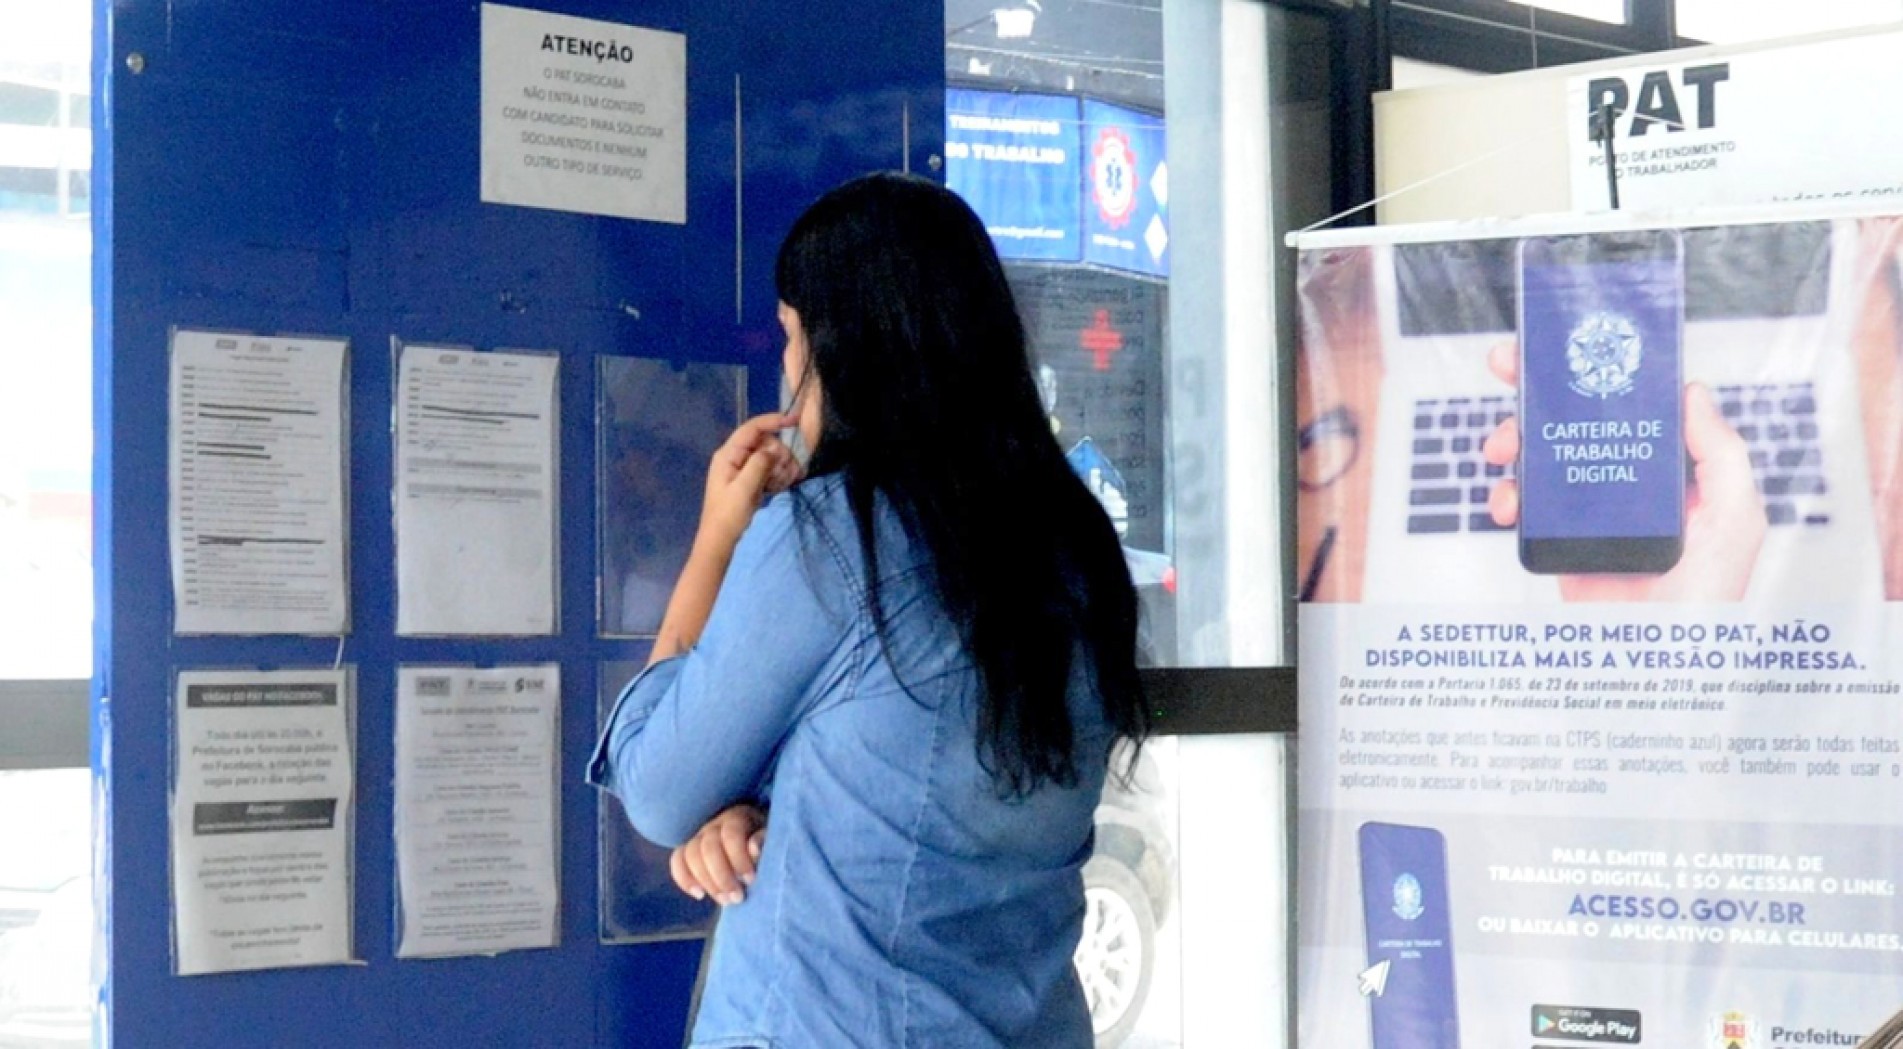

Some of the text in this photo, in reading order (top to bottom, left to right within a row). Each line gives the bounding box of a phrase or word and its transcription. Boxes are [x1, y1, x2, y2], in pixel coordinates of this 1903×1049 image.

[541, 33, 633, 63] ATENÇÃO
[543, 68, 626, 89] O PAT SOROCABA
[523, 85, 646, 115] NÃO ENTRA EM CONTATO
[1588, 62, 1730, 141] PAT
[502, 106, 664, 138] COM CANDIDATO PARA SOLICITAR
[521, 131, 592, 153] DOCUMENTOS
[603, 142, 647, 158] NENHUM
[1589, 140, 1736, 167] POTO DE ATENDIMENTO
[524, 154, 642, 181] OUTRO TIPO DE SERVIÇO
[1628, 158, 1718, 176] TRABALHADOR
[1542, 420, 1663, 440] CARTEIRA DE
[1552, 442, 1653, 461] TRABALHO
[1567, 465, 1639, 483] DIGITAL
[1397, 620, 1831, 646] A SEDETTUR, POR MEIO DO PAT, NÃO
[1365, 646, 1866, 670] DISPONIBILIZA MAIS A VERSÃO IMPRESSA.
[1340, 677, 1355, 689] De
[1358, 677, 1397, 690] acordo
[1401, 680, 1424, 690] com
[1428, 681, 1434, 690] a
[1438, 677, 1485, 690] Portaria
[1528, 678, 1542, 691] de
[1546, 678, 1560, 691] 23
[1565, 679, 1578, 691] de
[1583, 679, 1640, 692] setembro
[1644, 680, 1658, 692] de
[1700, 682, 1723, 695] que
[1727, 680, 1791, 695] disciplina
[1795, 681, 1831, 694] sobre
[1836, 684, 1842, 694] a
[1847, 681, 1900, 694] emissão
[1340, 694, 1354, 706] de
[1358, 694, 1405, 707] Carteira
[1409, 695, 1422, 707] de
[1426, 695, 1476, 708] Trabalho
[1491, 695, 1559, 708] Previdência
[1563, 696, 1600, 708] Social
[1604, 698, 1622, 709] em
[1626, 698, 1655, 710] meio
[1339, 728, 1900, 754] As anotações que antes ficavam na CTPS (caderninho azul) agora serão todas feitas
[1450, 752, 1478, 768] Para
[1488, 753, 1563, 772] acompanhar
[1574, 757, 1608, 771] essas
[1699, 758, 1729, 774] você
[1741, 758, 1796, 775] também
[1807, 760, 1840, 777] pode
[1851, 761, 1880, 776] usar
[1892, 763, 1900, 776] o
[1339, 773, 1398, 791] aplicativo
[1401, 776, 1416, 789] ou
[1420, 777, 1464, 790] acessar
[1470, 778, 1476, 790] o
[1510, 777, 1607, 795] gov.br/trabalho
[1552, 848, 1823, 872] PARA EMITIR A CARTEIRA DE
[1488, 865, 1587, 885] TRABALHO
[1591, 870, 1672, 890] DIGITAL,
[1692, 871, 1720, 889] SÓ
[1726, 874, 1815, 892] ACESSAR
[1821, 877, 1838, 893] O
[1843, 879, 1894, 896] LINK:
[1568, 893, 1805, 924] ACESSO.GOV.BR
[1478, 917, 1903, 950] OU BAIXAR O APLICATIVO PARA CELULARES.
[1559, 1018, 1637, 1040] Google Play
[1771, 1026, 1866, 1046] Prefeitur
